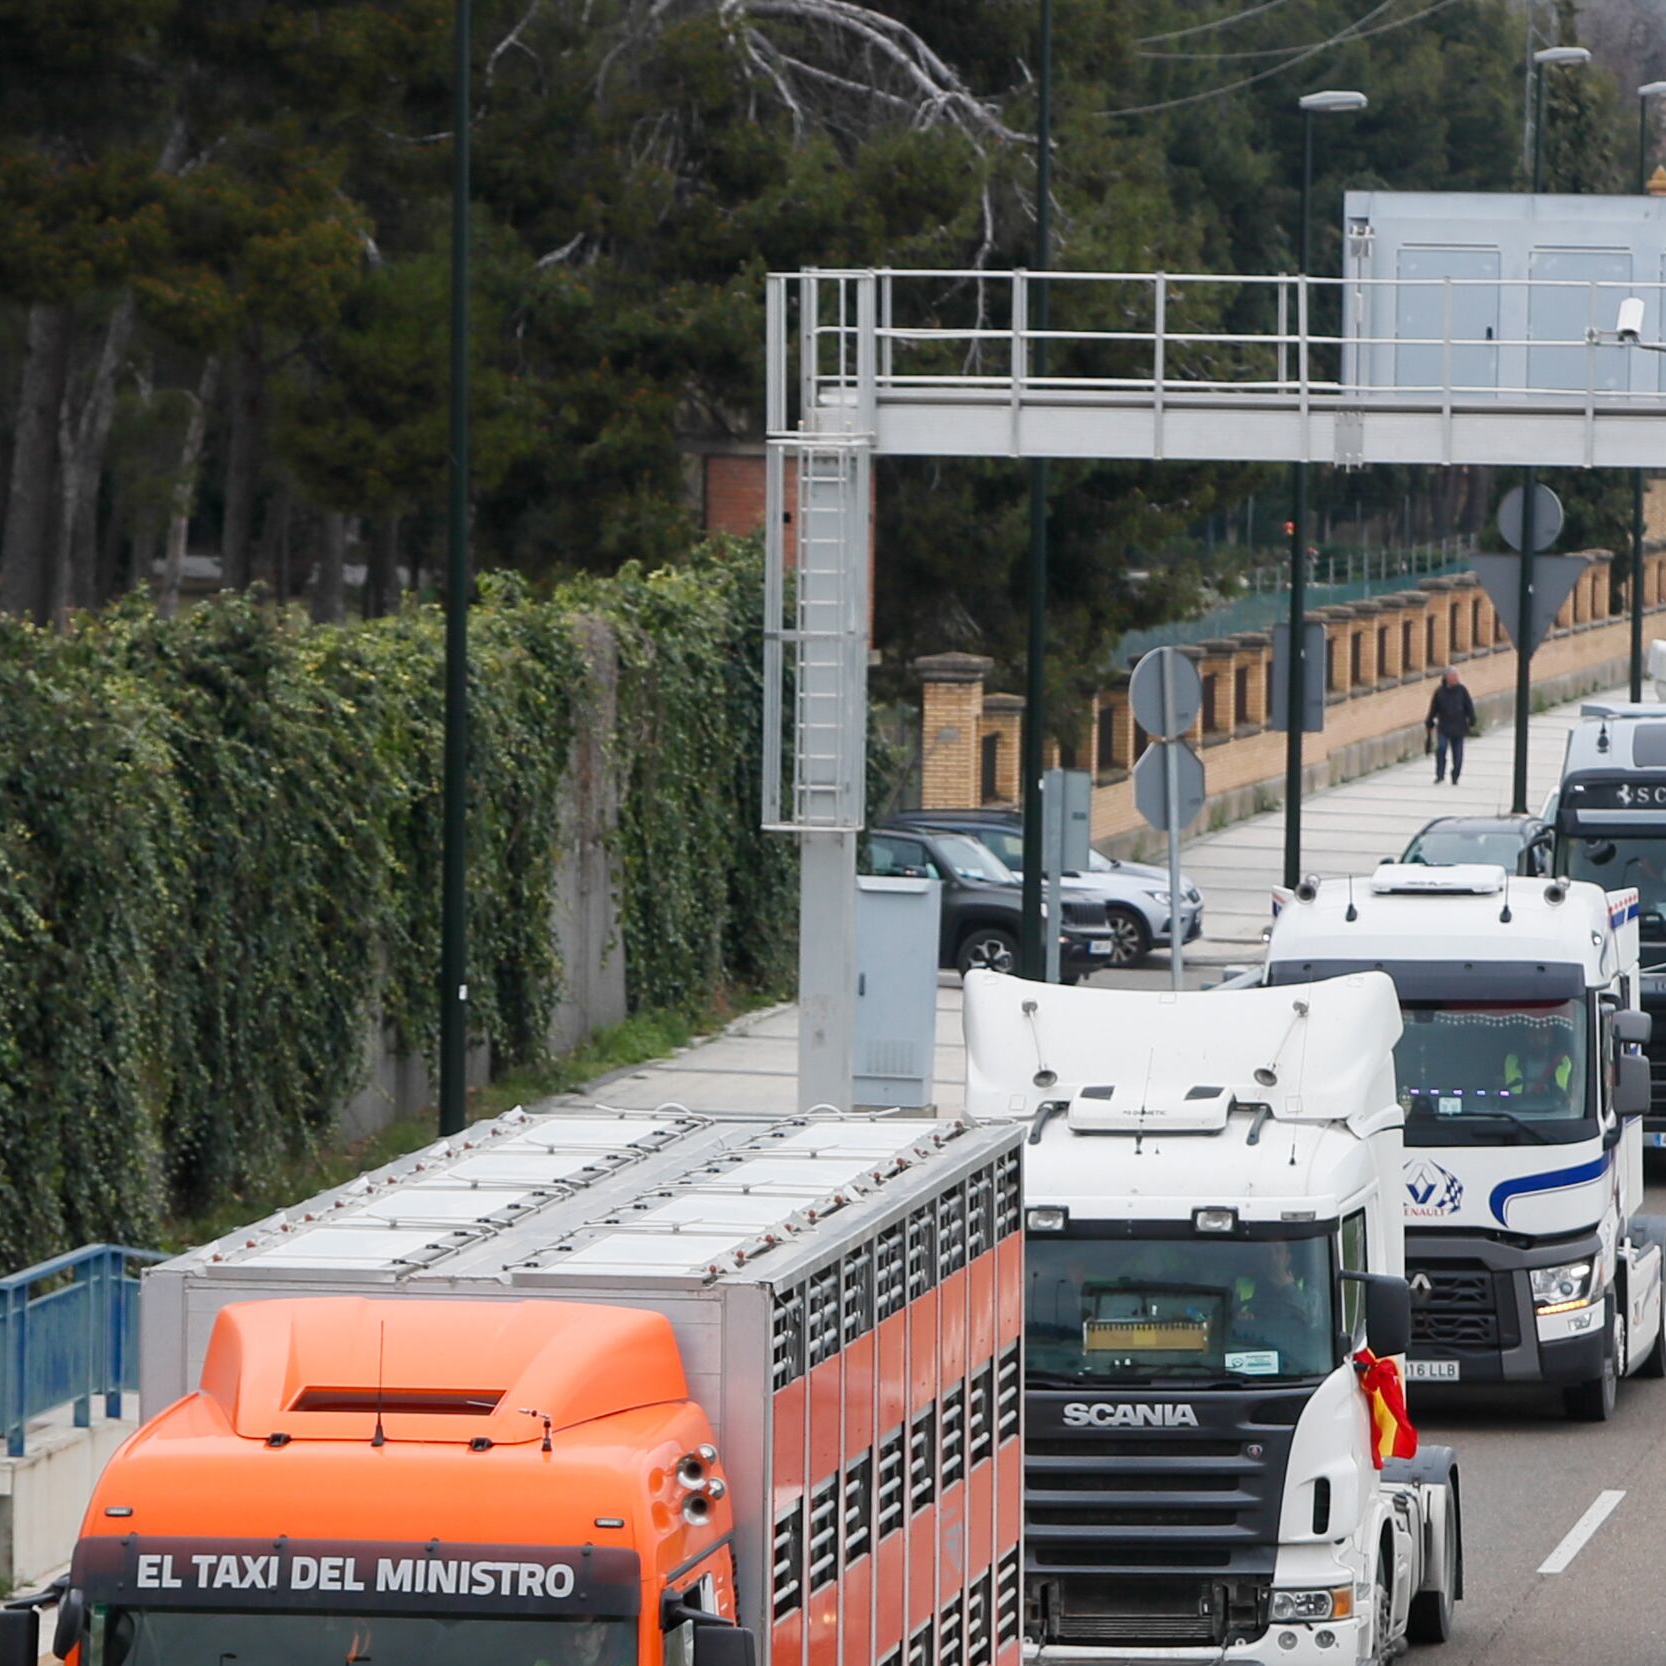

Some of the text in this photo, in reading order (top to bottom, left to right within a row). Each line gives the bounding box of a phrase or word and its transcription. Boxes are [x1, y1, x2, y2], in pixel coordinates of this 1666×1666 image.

[1402, 1206, 1445, 1217] ENAULT
[1429, 1363, 1455, 1377] LLB
[1062, 1402, 1199, 1427] SCANIA
[136, 1554, 576, 1598] EL TAXI DEL MINISTRO
